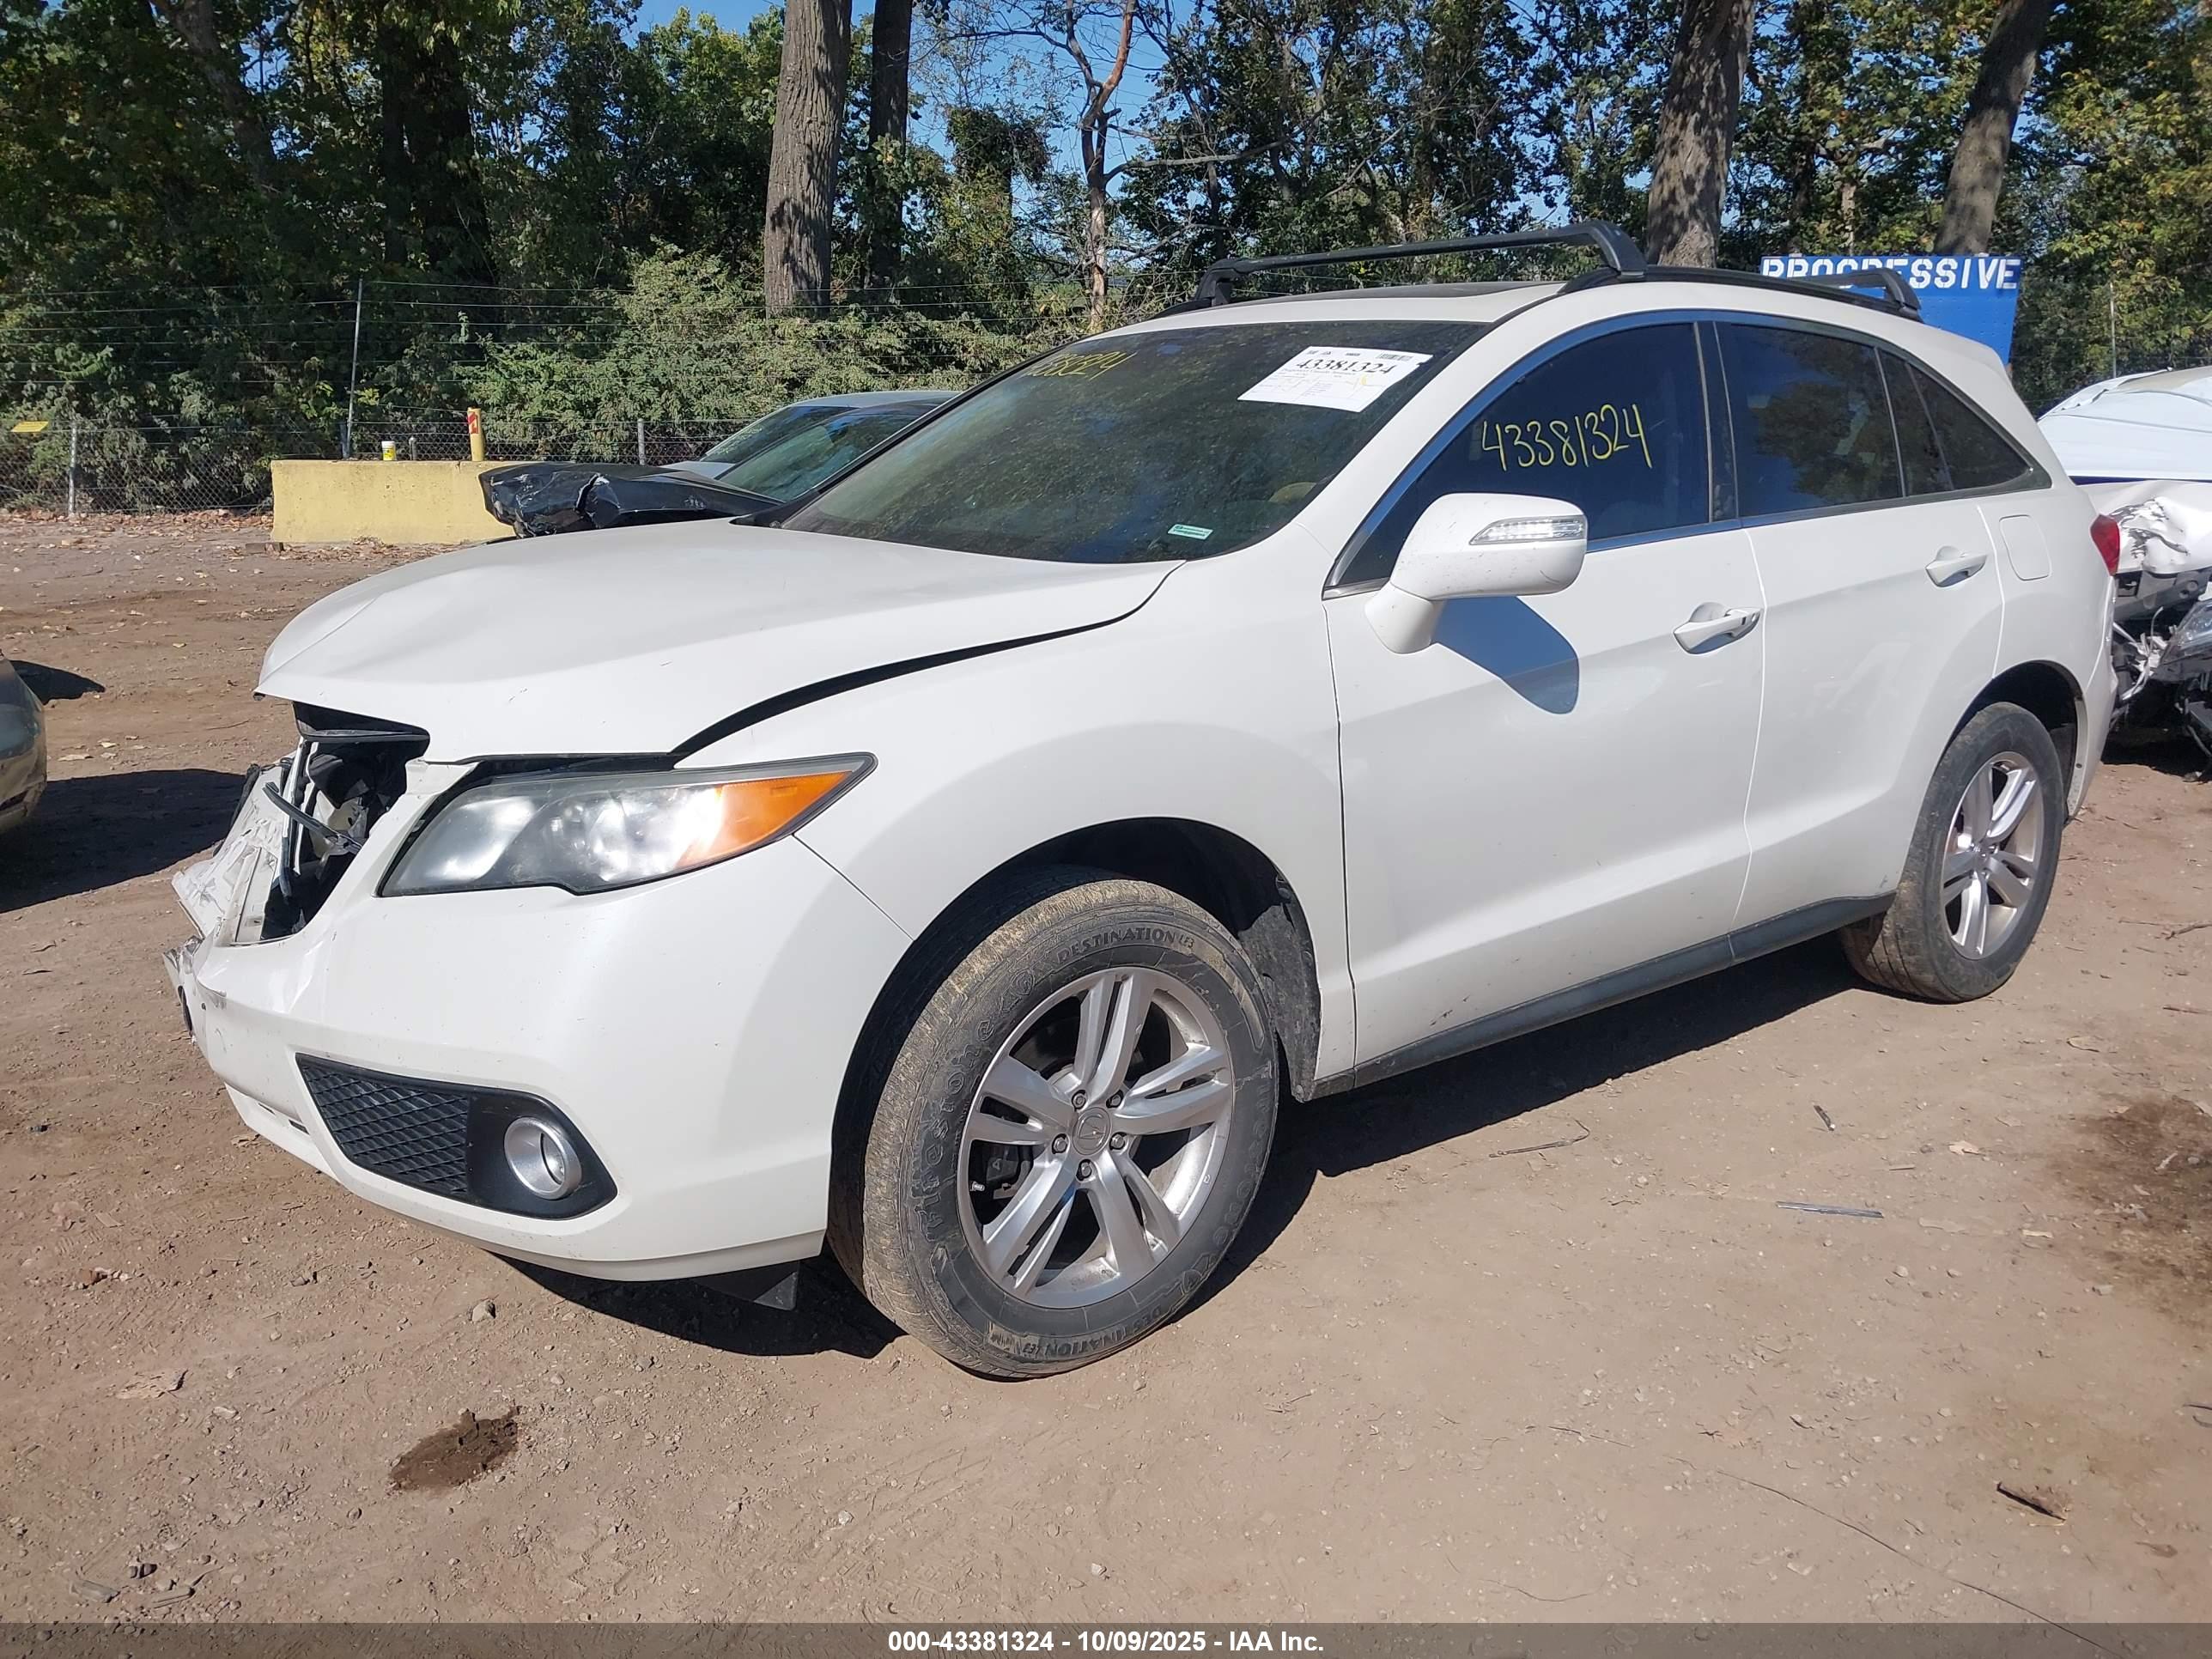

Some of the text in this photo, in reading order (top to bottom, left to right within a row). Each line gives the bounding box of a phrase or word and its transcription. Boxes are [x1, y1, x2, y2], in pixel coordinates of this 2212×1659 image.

[1297, 358, 1397, 374] 43381324
[1481, 404, 1653, 471] 43381324
[1056, 927, 1176, 963] DESTINATION
